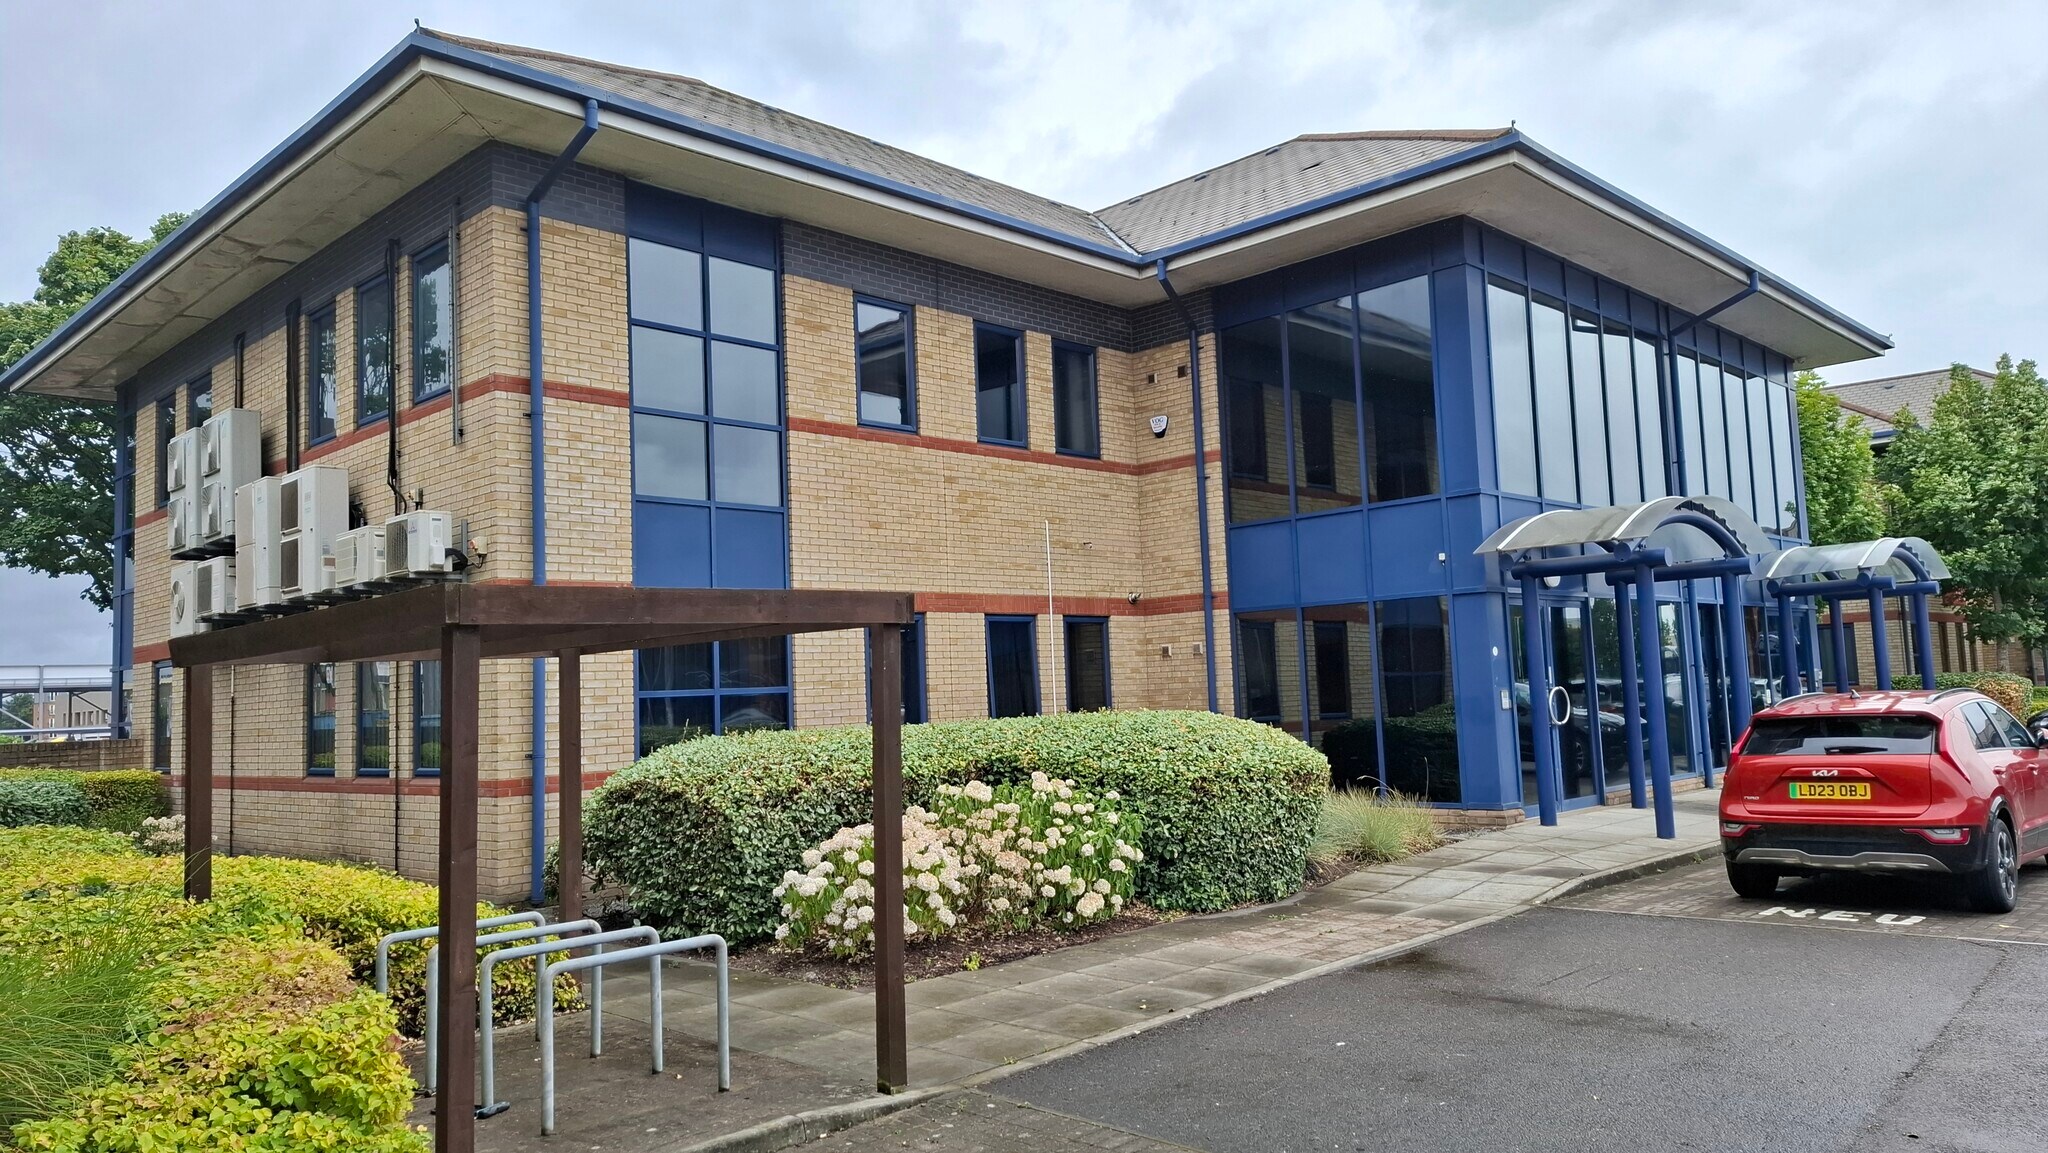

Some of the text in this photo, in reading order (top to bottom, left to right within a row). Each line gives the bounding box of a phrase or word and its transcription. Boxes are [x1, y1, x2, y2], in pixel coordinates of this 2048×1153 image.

[1798, 784, 1868, 797] LD23 OBJ
[1758, 906, 1927, 925] NEU
